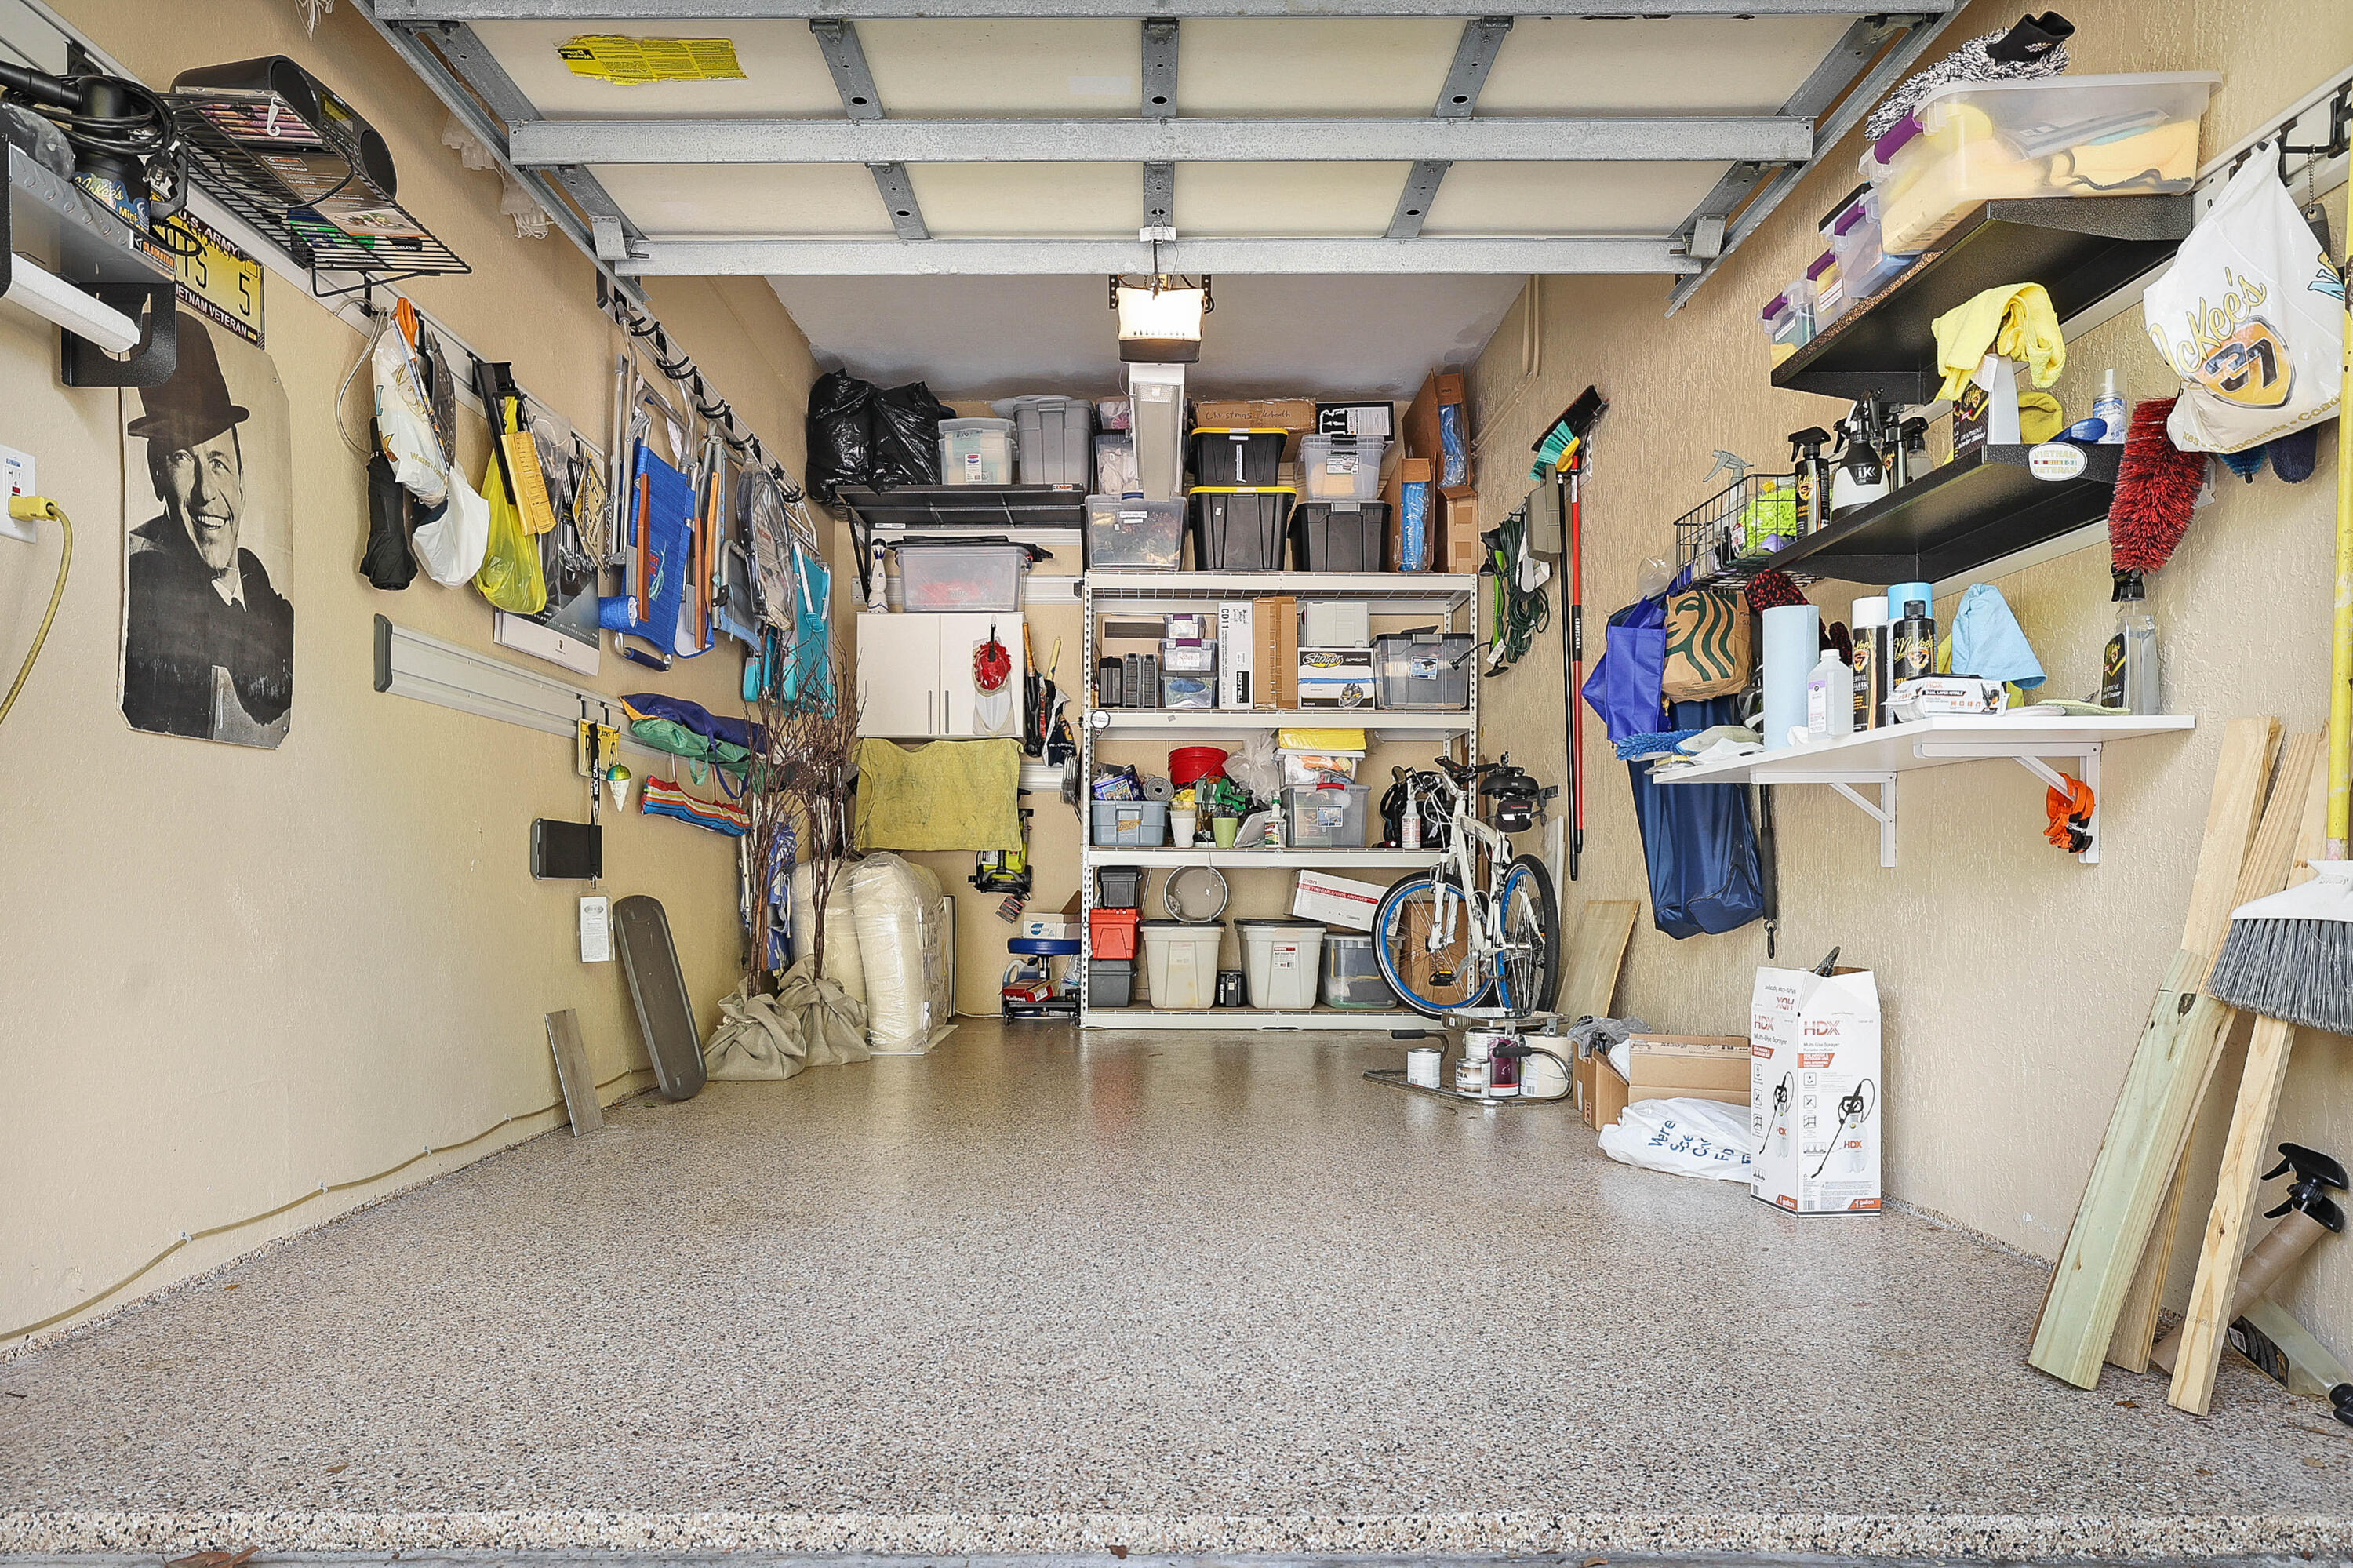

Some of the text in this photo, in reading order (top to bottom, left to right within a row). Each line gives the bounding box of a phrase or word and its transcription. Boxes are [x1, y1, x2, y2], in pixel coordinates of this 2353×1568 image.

[177, 211, 202, 233] U.S.
[204, 227, 239, 255] ARMY
[176, 285, 248, 337] IETNAM VETERAN
[2204, 337, 2278, 393] 37
[1205, 410, 1253, 420] Christmas
[2033, 449, 2078, 459] VIETNAM
[2033, 466, 2078, 475] VETERAN
[1221, 608, 1230, 628] CD11
[1303, 652, 1344, 668] Stinger
[1854, 653, 1865, 666] 37
[1776, 996, 1795, 1010] HDX
[1754, 1013, 1776, 1031] HDX
[1804, 1020, 1841, 1036] HDX
[1777, 1127, 1787, 1137] HDX
[1843, 1140, 1863, 1149] HDX
